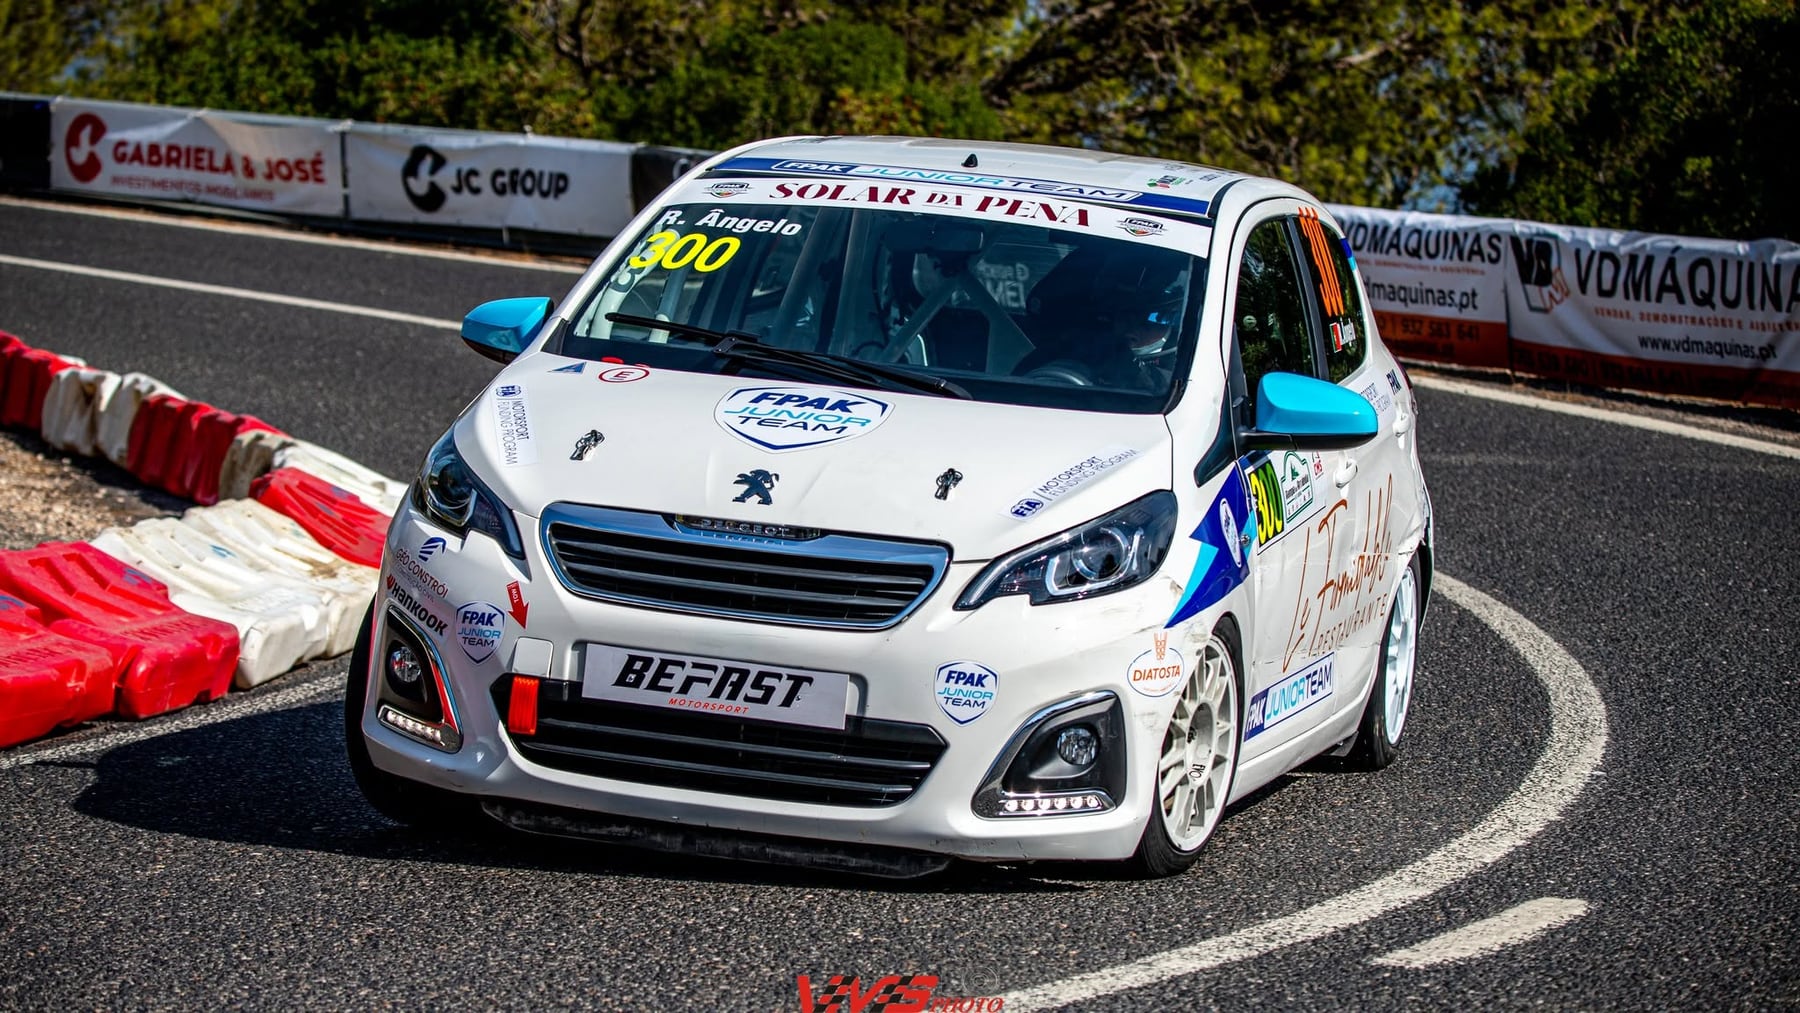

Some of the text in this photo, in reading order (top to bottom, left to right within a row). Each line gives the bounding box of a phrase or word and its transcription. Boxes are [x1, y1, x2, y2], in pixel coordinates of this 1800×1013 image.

[112, 139, 328, 185] GABRIELA & JOSÉ
[784, 162, 846, 177] FPAK
[450, 168, 570, 200] JC GROUP
[769, 182, 1090, 227] SOLAR DA PENA
[662, 208, 803, 237] R. Ângelo
[628, 231, 741, 273] 300
[1637, 334, 1779, 361] www.vdmaquinas.pt
[613, 371, 635, 380] E
[748, 392, 868, 413] FPAK
[512, 401, 530, 440] MOTORSPORT
[724, 406, 872, 427] JUNIOR
[738, 415, 848, 434] TEAM
[1038, 456, 1102, 494] MOTORSPORT
[1013, 499, 1041, 517] FIA
[1249, 461, 1282, 545] 300
[407, 560, 449, 599] CONSTRÓI
[461, 610, 498, 627] FPAK
[1317, 593, 1388, 657] RESTAURANTE
[457, 628, 501, 640] JUNIOR
[463, 637, 495, 648] TEAM
[611, 653, 815, 708] BEFAST
[945, 670, 989, 688] FPAK
[1132, 665, 1181, 682] DIATOSTA
[937, 687, 994, 700] JUNIOR
[944, 696, 986, 709] TEAM
[668, 697, 750, 715] MOTORSPORT
[1245, 698, 1269, 738] FPAK
